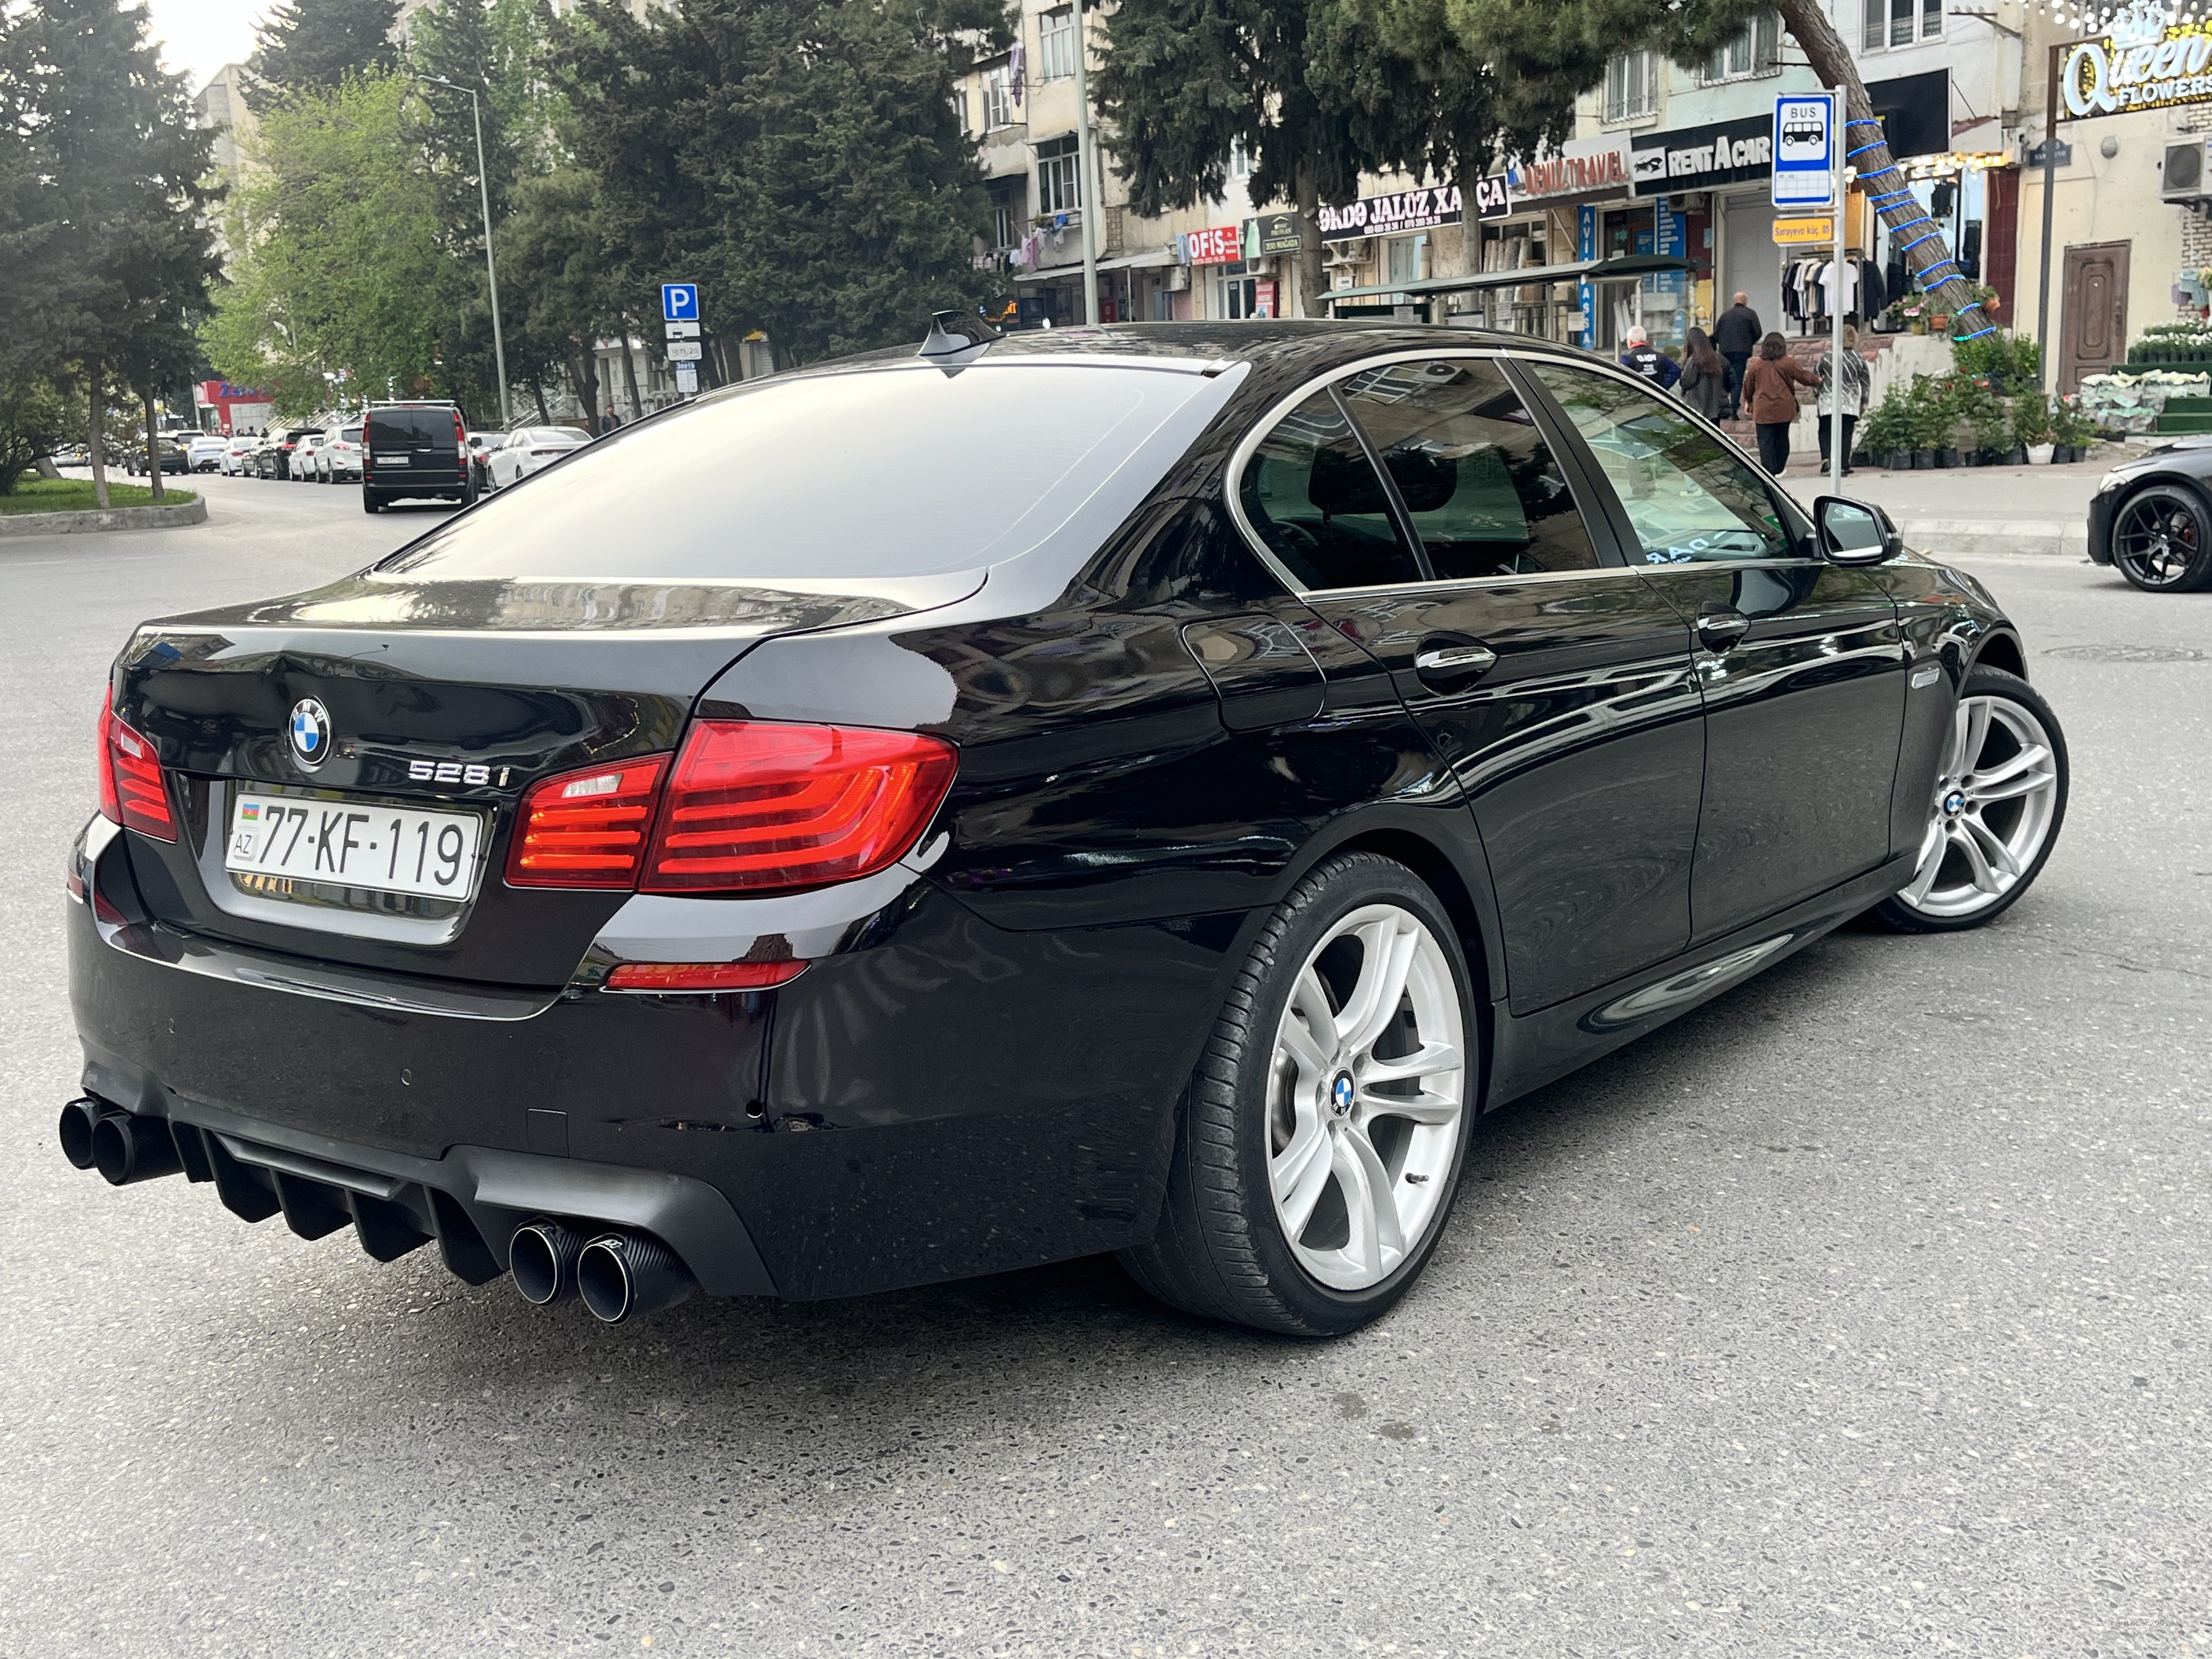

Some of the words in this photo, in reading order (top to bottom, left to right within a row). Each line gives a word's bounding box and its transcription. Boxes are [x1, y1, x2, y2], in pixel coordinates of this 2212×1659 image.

[2063, 34, 2212, 116] Queen
[1791, 107, 1816, 119] BUS
[1566, 150, 1629, 188] TRAVEL
[1370, 191, 1429, 224] JALÜZ
[1433, 179, 1506, 215] XAÇA
[670, 289, 690, 316] P
[292, 701, 325, 723] BMW
[234, 833, 252, 854] AZ
[258, 805, 464, 886] 77-KF-119
